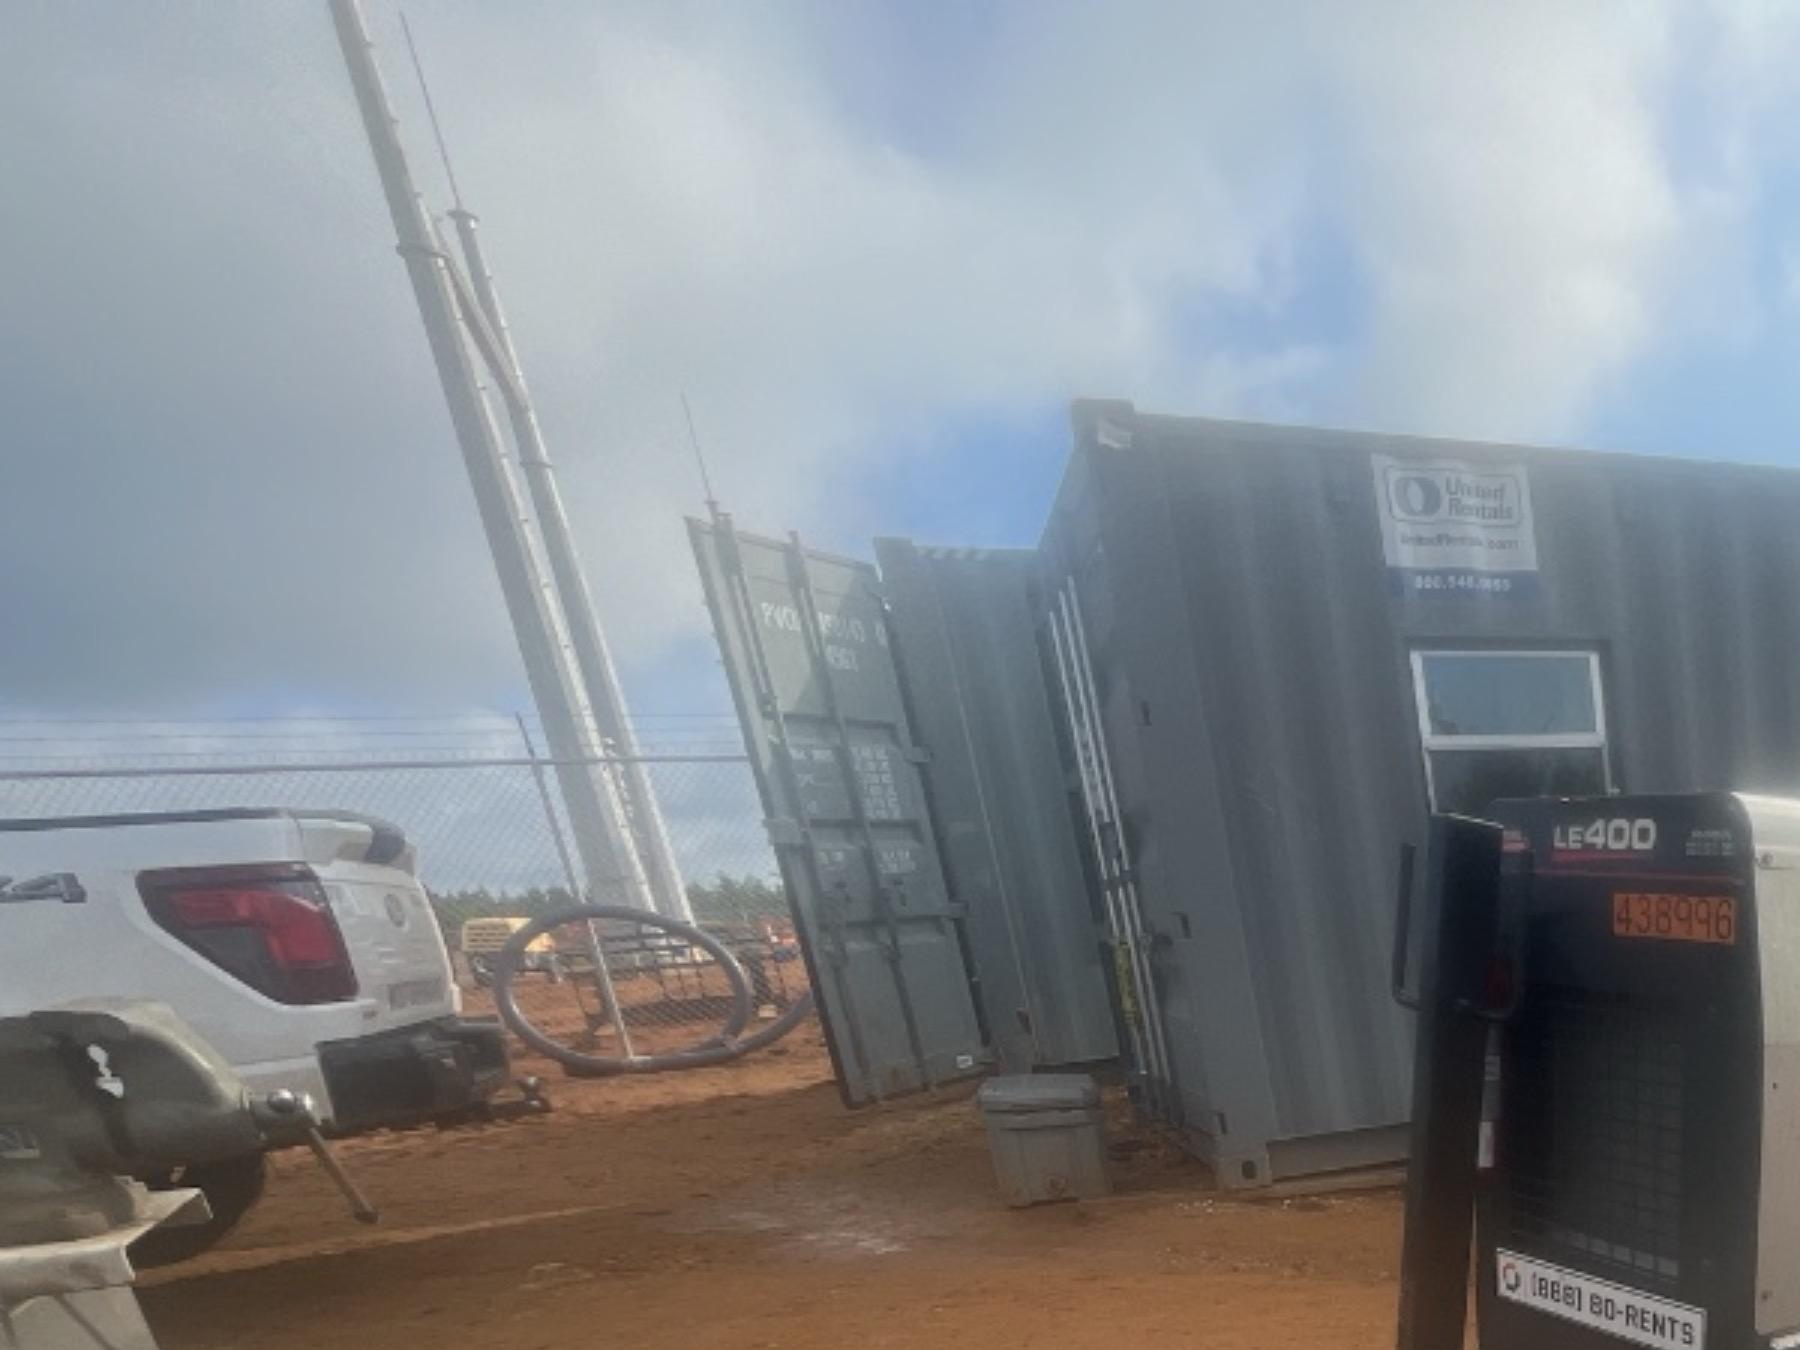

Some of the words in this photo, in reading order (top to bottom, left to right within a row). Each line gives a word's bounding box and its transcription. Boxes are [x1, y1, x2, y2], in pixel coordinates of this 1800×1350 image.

[1553, 818, 1657, 850] LE400
[1615, 894, 1733, 939] 438996
[1589, 1292, 1694, 1346] 80-RENTS
